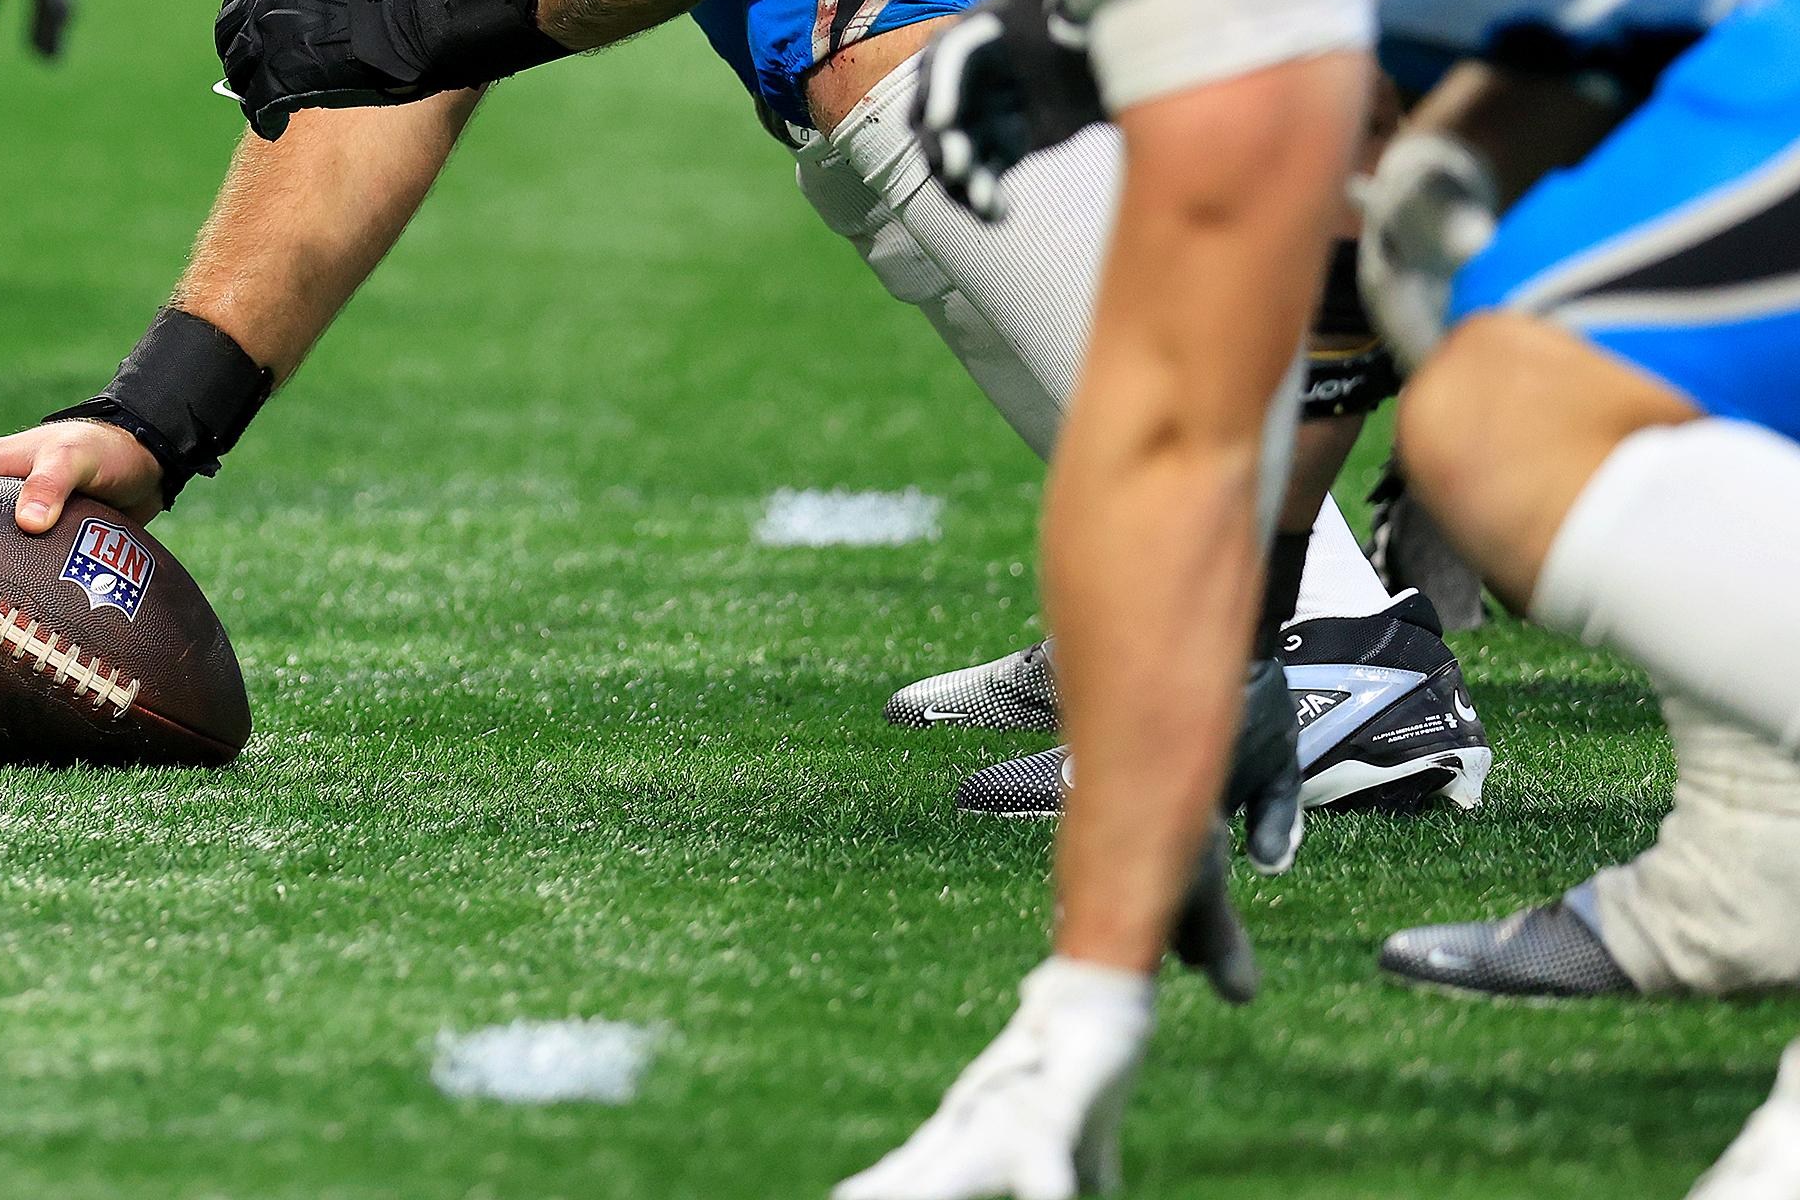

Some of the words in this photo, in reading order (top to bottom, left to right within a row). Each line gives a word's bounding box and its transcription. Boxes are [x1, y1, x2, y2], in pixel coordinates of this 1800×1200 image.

[88, 526, 148, 585] NFL
[1372, 730, 1396, 742] ALPHA
[1419, 725, 1445, 735] POWER
